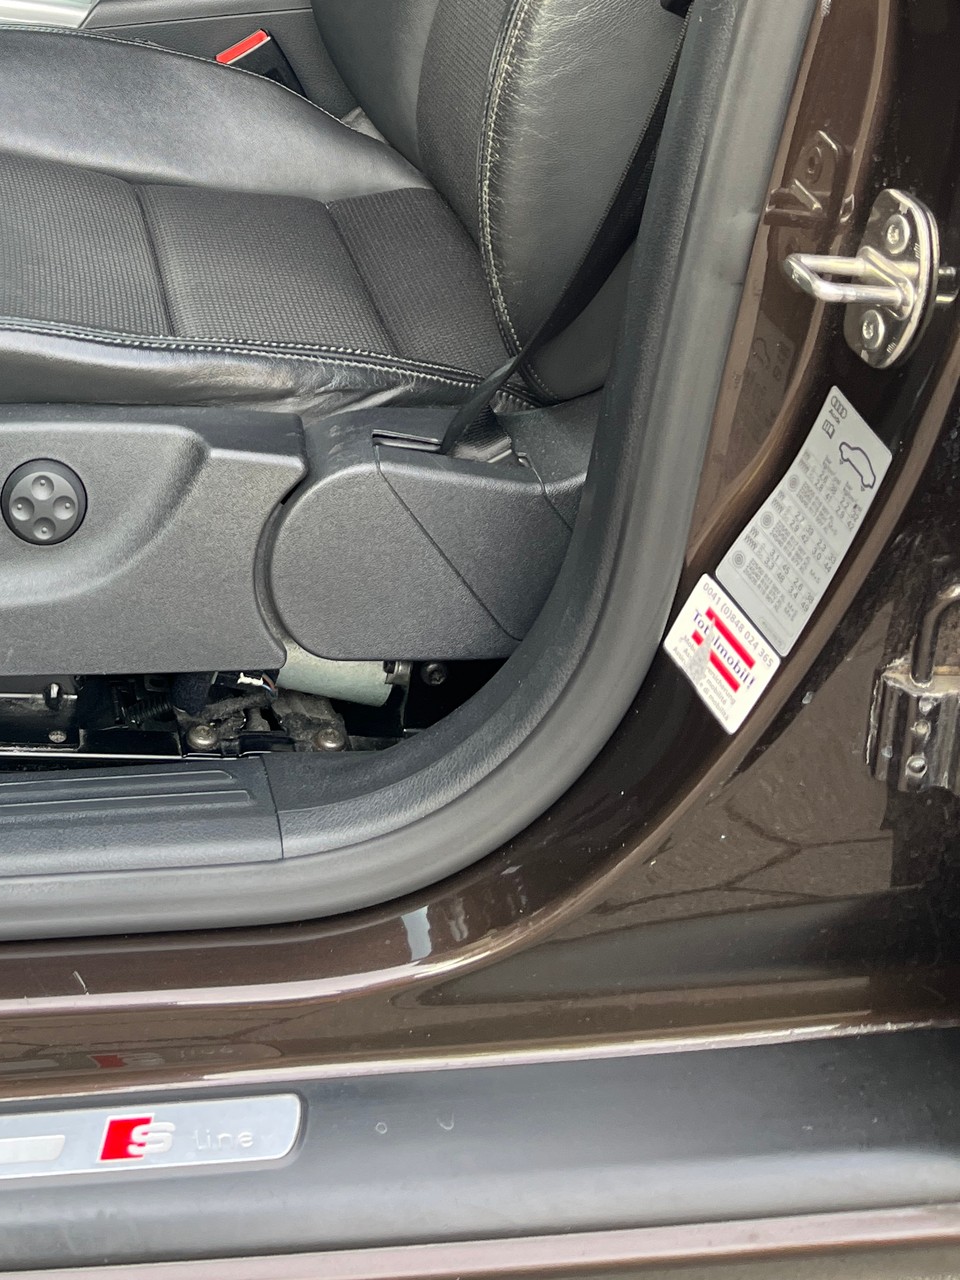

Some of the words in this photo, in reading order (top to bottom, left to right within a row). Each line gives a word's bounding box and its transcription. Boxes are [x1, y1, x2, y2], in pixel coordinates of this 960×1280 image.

[781, 563, 790, 575] 45
[691, 607, 754, 689] Totlmobil!
[703, 581, 721, 605] 0041
[720, 602, 744, 634] (0)848
[743, 630, 759, 650] 024
[758, 647, 773, 668] 365
[193, 1128, 254, 1151] line
